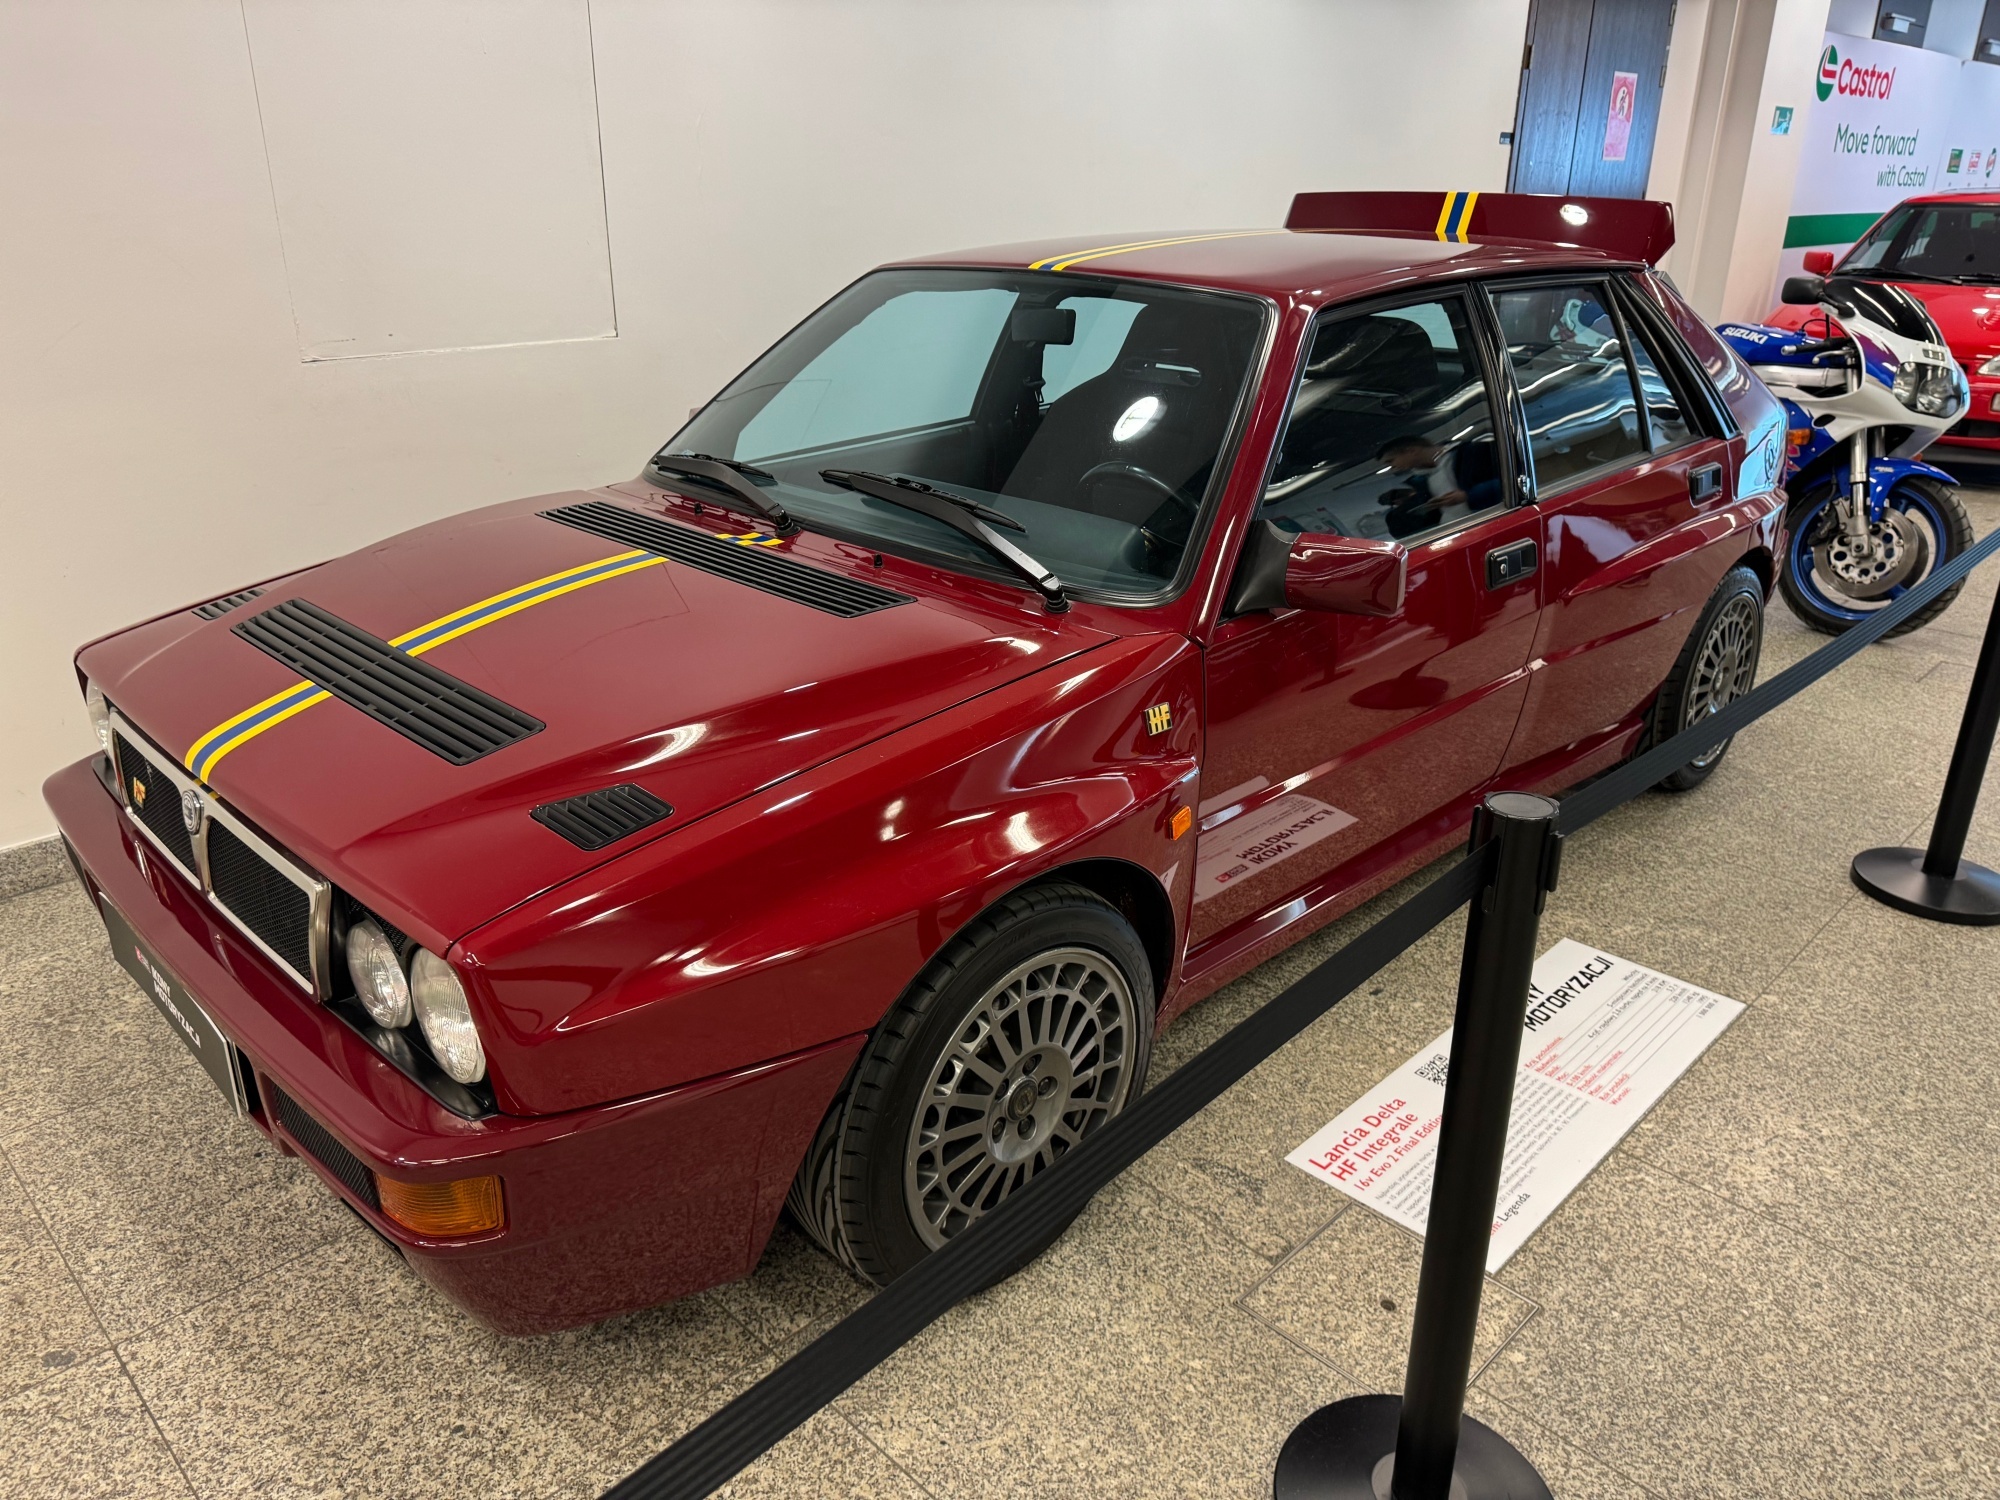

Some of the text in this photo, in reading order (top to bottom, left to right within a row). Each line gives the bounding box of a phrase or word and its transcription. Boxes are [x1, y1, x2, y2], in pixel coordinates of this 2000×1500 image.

[1838, 58, 1896, 100] Castrol
[1834, 123, 1919, 156] Move forward
[1877, 164, 1929, 187] with Castrol
[1722, 326, 1768, 344] SUZUKI
[1524, 956, 1614, 1032] MOTORYZACJI
[1308, 1099, 1406, 1171] Lancia Delta
[1330, 1114, 1418, 1182] HF Integrale
[1354, 1176, 1374, 1191] 16v
[1370, 1162, 1392, 1177] Evo
[1386, 1154, 1399, 1163] 2
[1393, 1136, 1419, 1157] Final
[1496, 1193, 1531, 1222] Legenda
